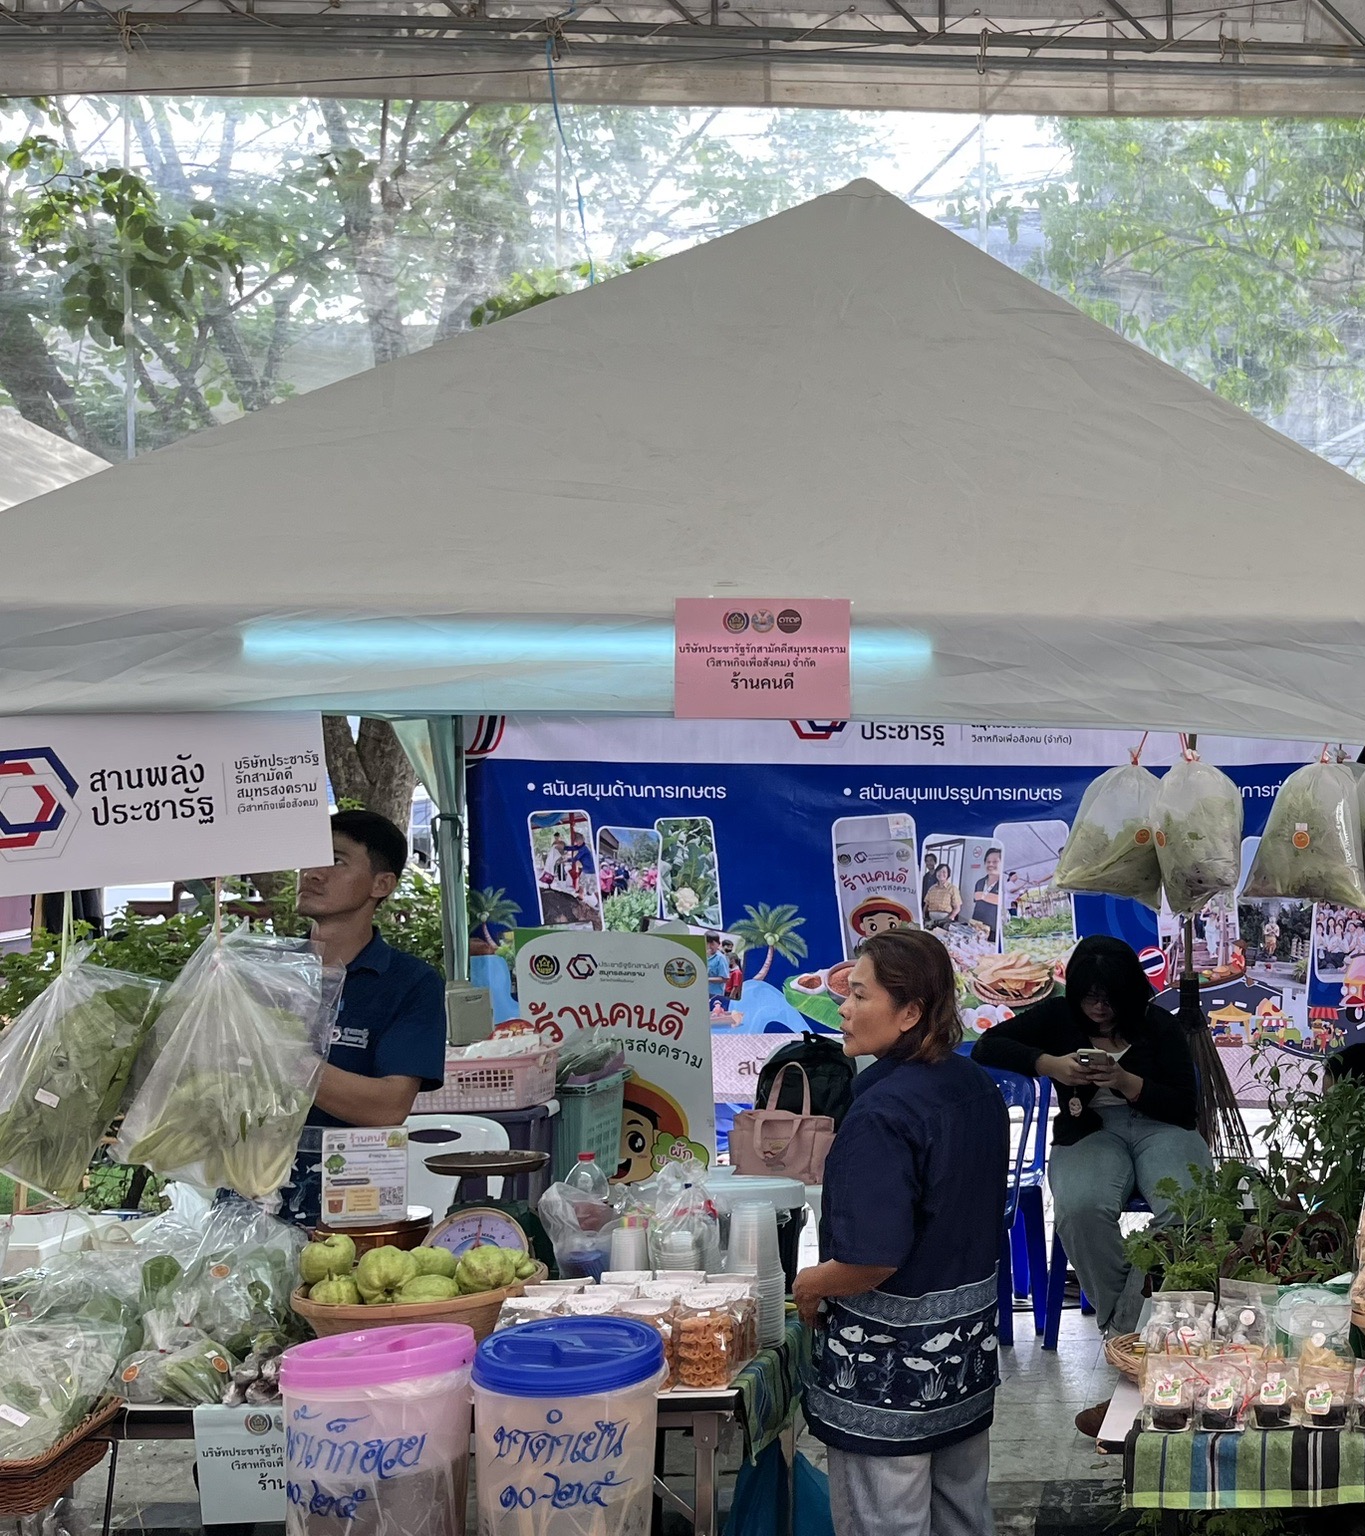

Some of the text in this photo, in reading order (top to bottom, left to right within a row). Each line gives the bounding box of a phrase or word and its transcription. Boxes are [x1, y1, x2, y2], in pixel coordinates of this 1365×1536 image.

[778, 616, 801, 624] OTOP
[679, 642, 847, 657] บริษัทประชารัฐรักสามัคคีสมุทรสงคราม
[706, 655, 816, 668] (วิสาหกิจเพื่อสังคม) จำกัด
[730, 671, 795, 690] ร้านคนดี
[860, 721, 945, 747] ประชารฐ
[971, 733, 1073, 746] วิสาหกิจเพื่อสังคม (จำกัด)
[234, 750, 320, 770] บริษัทประชารัฐ
[90, 753, 206, 793] สานพลัง
[235, 766, 293, 784] รักสามัคคี
[236, 781, 318, 800] สมุทรสงคราม
[541, 778, 727, 802] สนับสนุนด้านการเกษตร
[859, 783, 1063, 806] สนับสนุนแปรรูปการเกษตร
[91, 786, 215, 826] ประชารัฐ
[236, 798, 319, 815] (วิสาหกิจเพื่อสังคม)
[840, 867, 909, 891] ร้านคนดี
[528, 1001, 690, 1043] ร้านคนดี
[670, 1141, 693, 1160] ผัก
[202, 1443, 285, 1458] บริษัทประชารัฐรัก
[230, 1454, 284, 1471] (วิสาหกิจเพื่
[257, 1472, 286, 1491] ร้าน
